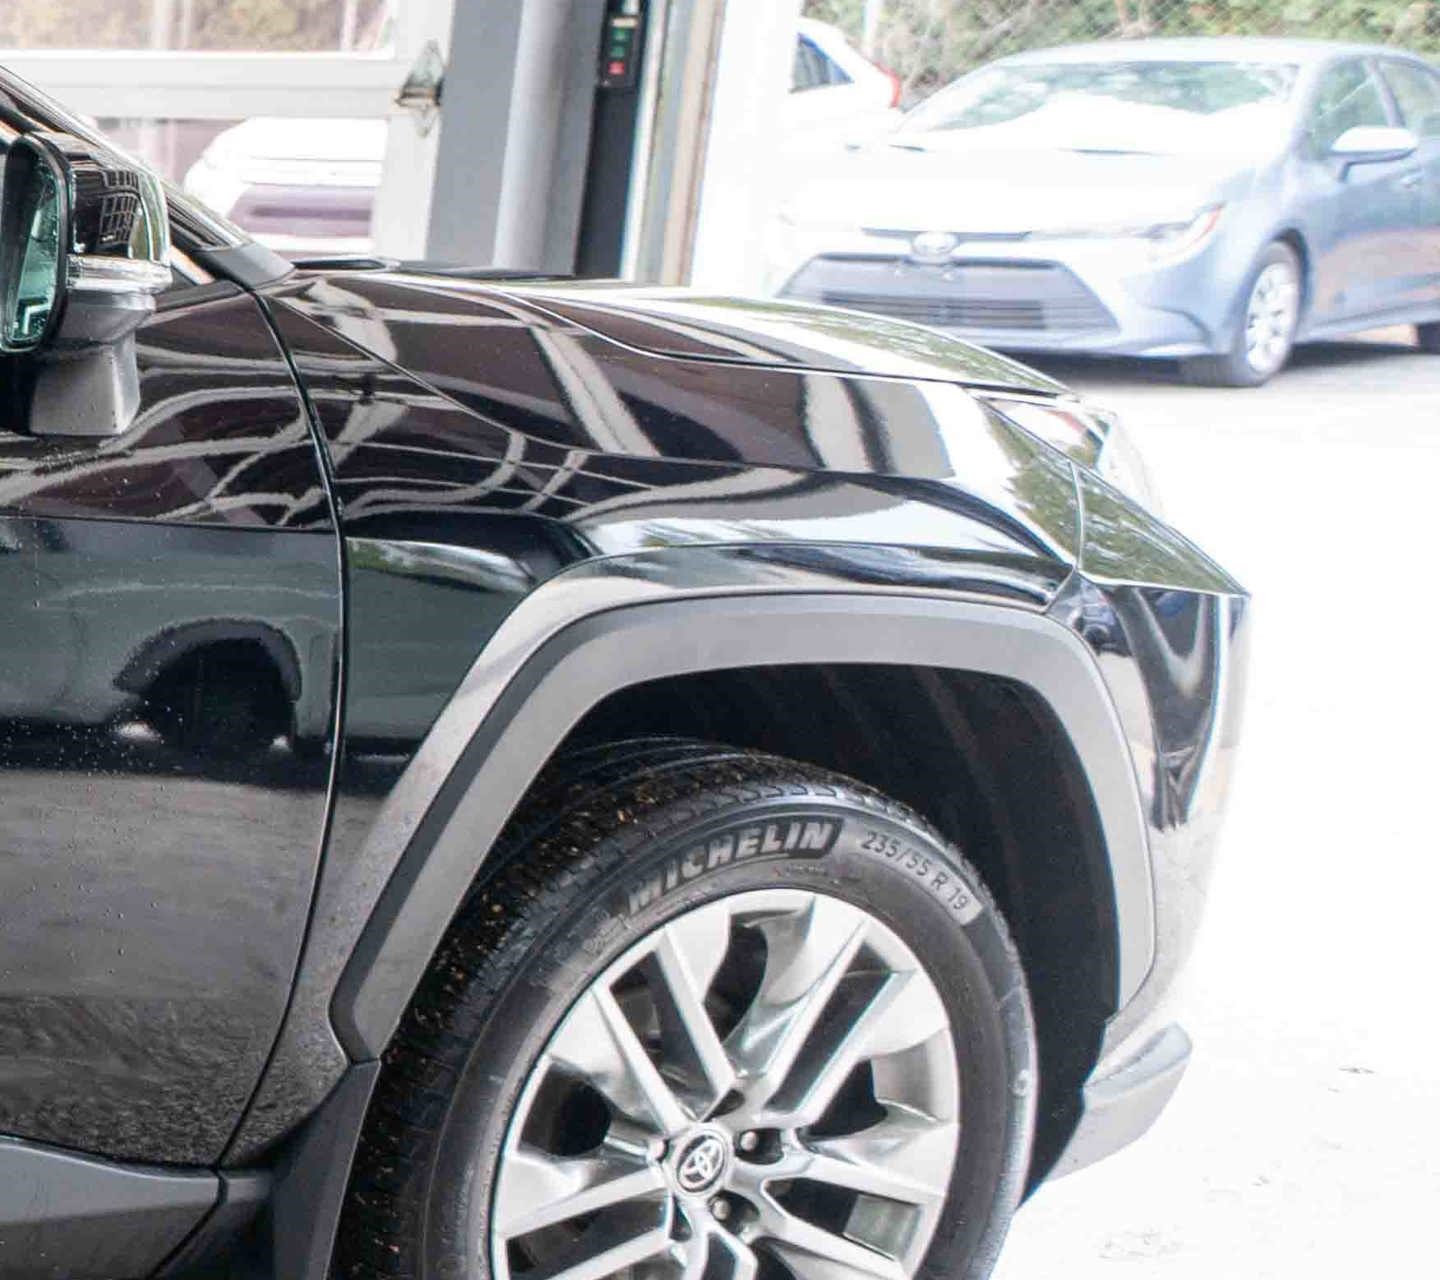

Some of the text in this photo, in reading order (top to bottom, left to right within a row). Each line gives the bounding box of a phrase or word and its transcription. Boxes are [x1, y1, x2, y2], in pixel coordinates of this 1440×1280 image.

[628, 820, 833, 917] MICHELIN
[861, 830, 968, 911] 235/55 R 19
